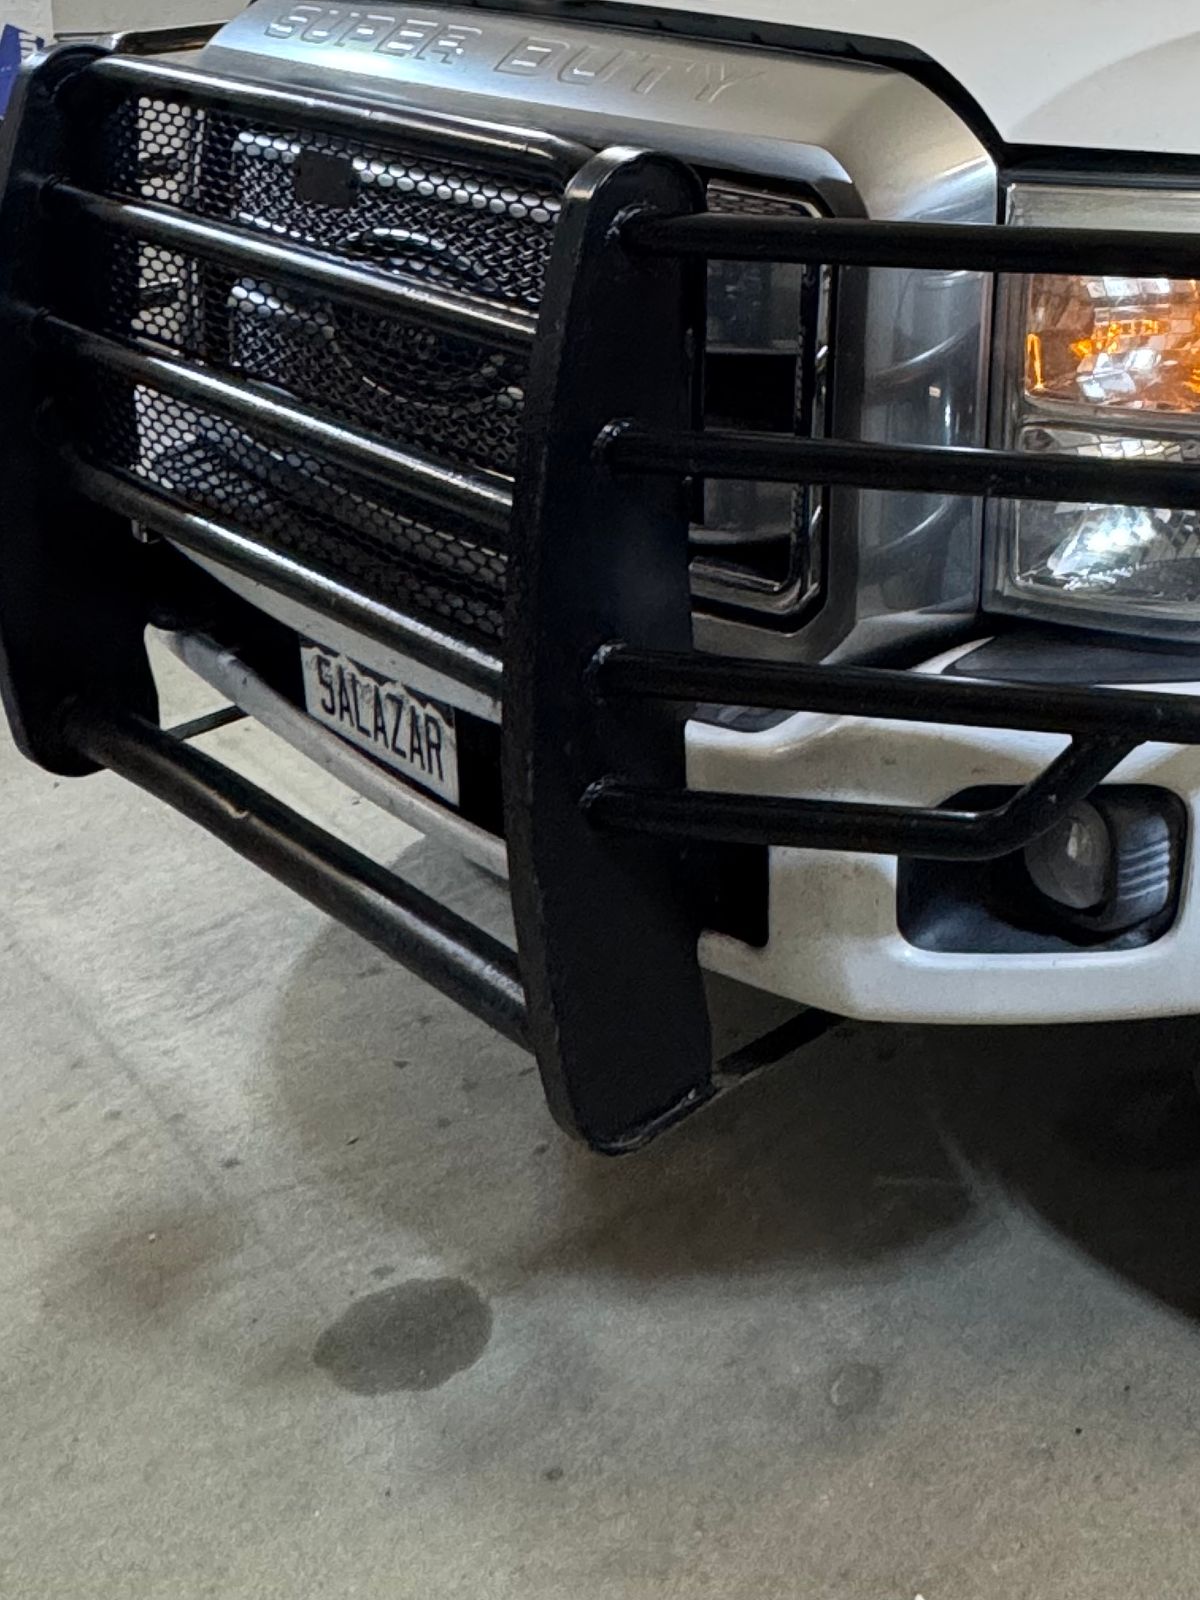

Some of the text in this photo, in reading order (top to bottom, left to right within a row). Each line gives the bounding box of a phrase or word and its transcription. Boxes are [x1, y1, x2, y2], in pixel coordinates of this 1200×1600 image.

[263, 4, 767, 104] SUPER DUTY
[315, 653, 445, 783] SALAZAR
